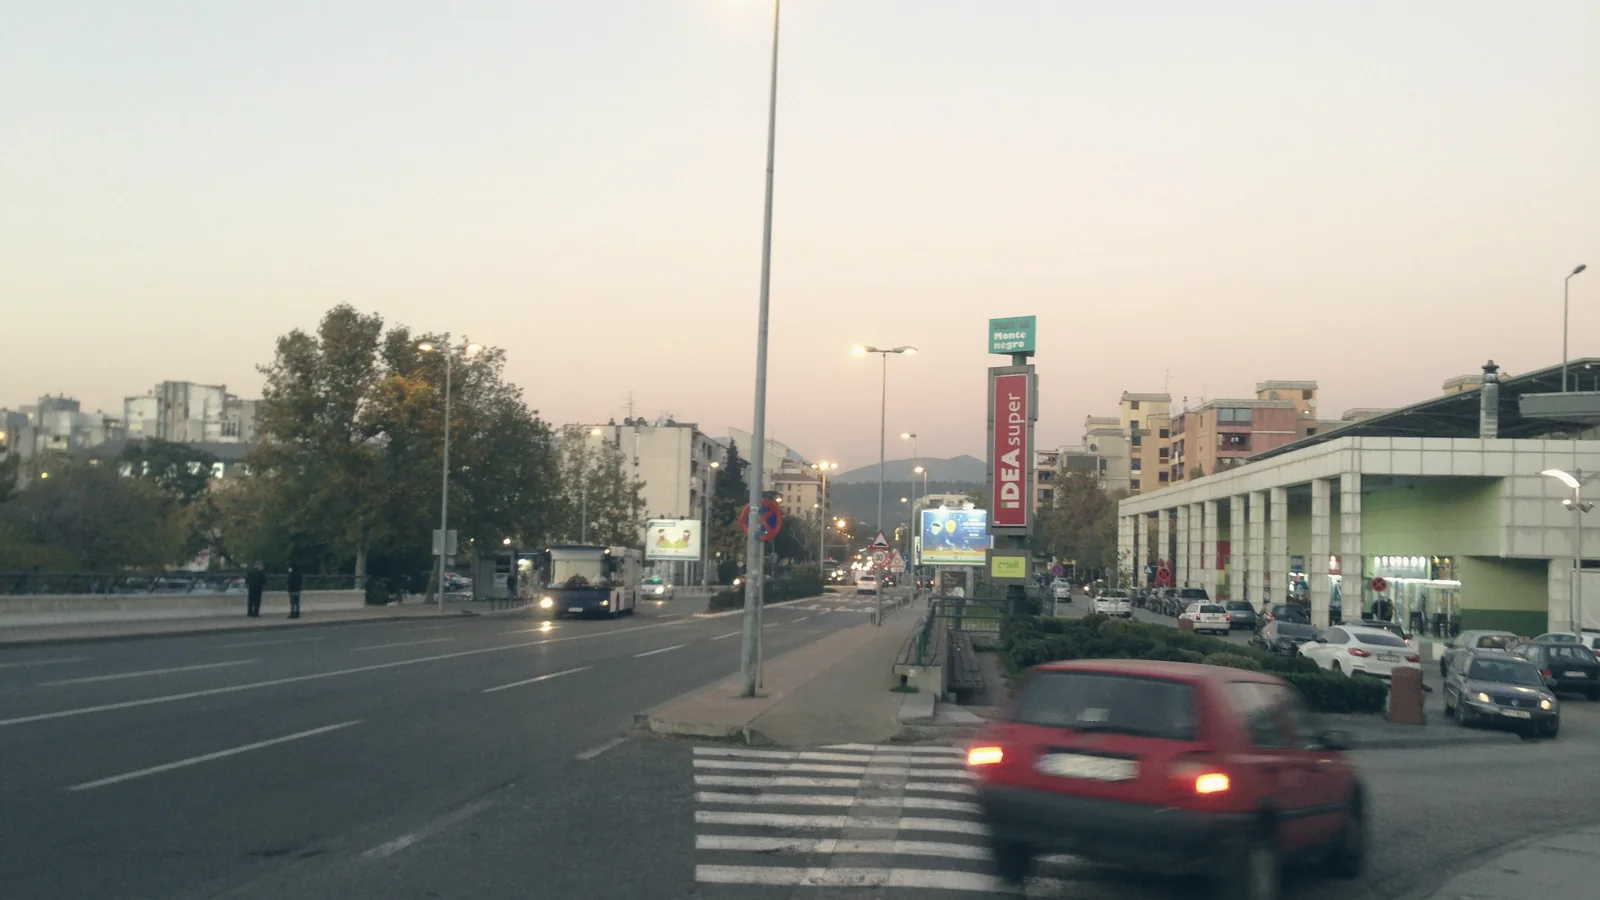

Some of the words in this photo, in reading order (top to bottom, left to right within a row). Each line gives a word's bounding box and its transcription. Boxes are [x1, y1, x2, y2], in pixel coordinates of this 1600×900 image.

[994, 332, 1026, 340] Monte
[994, 341, 1025, 350] negro
[1008, 392, 1025, 446] super
[875, 553, 884, 562] 30
